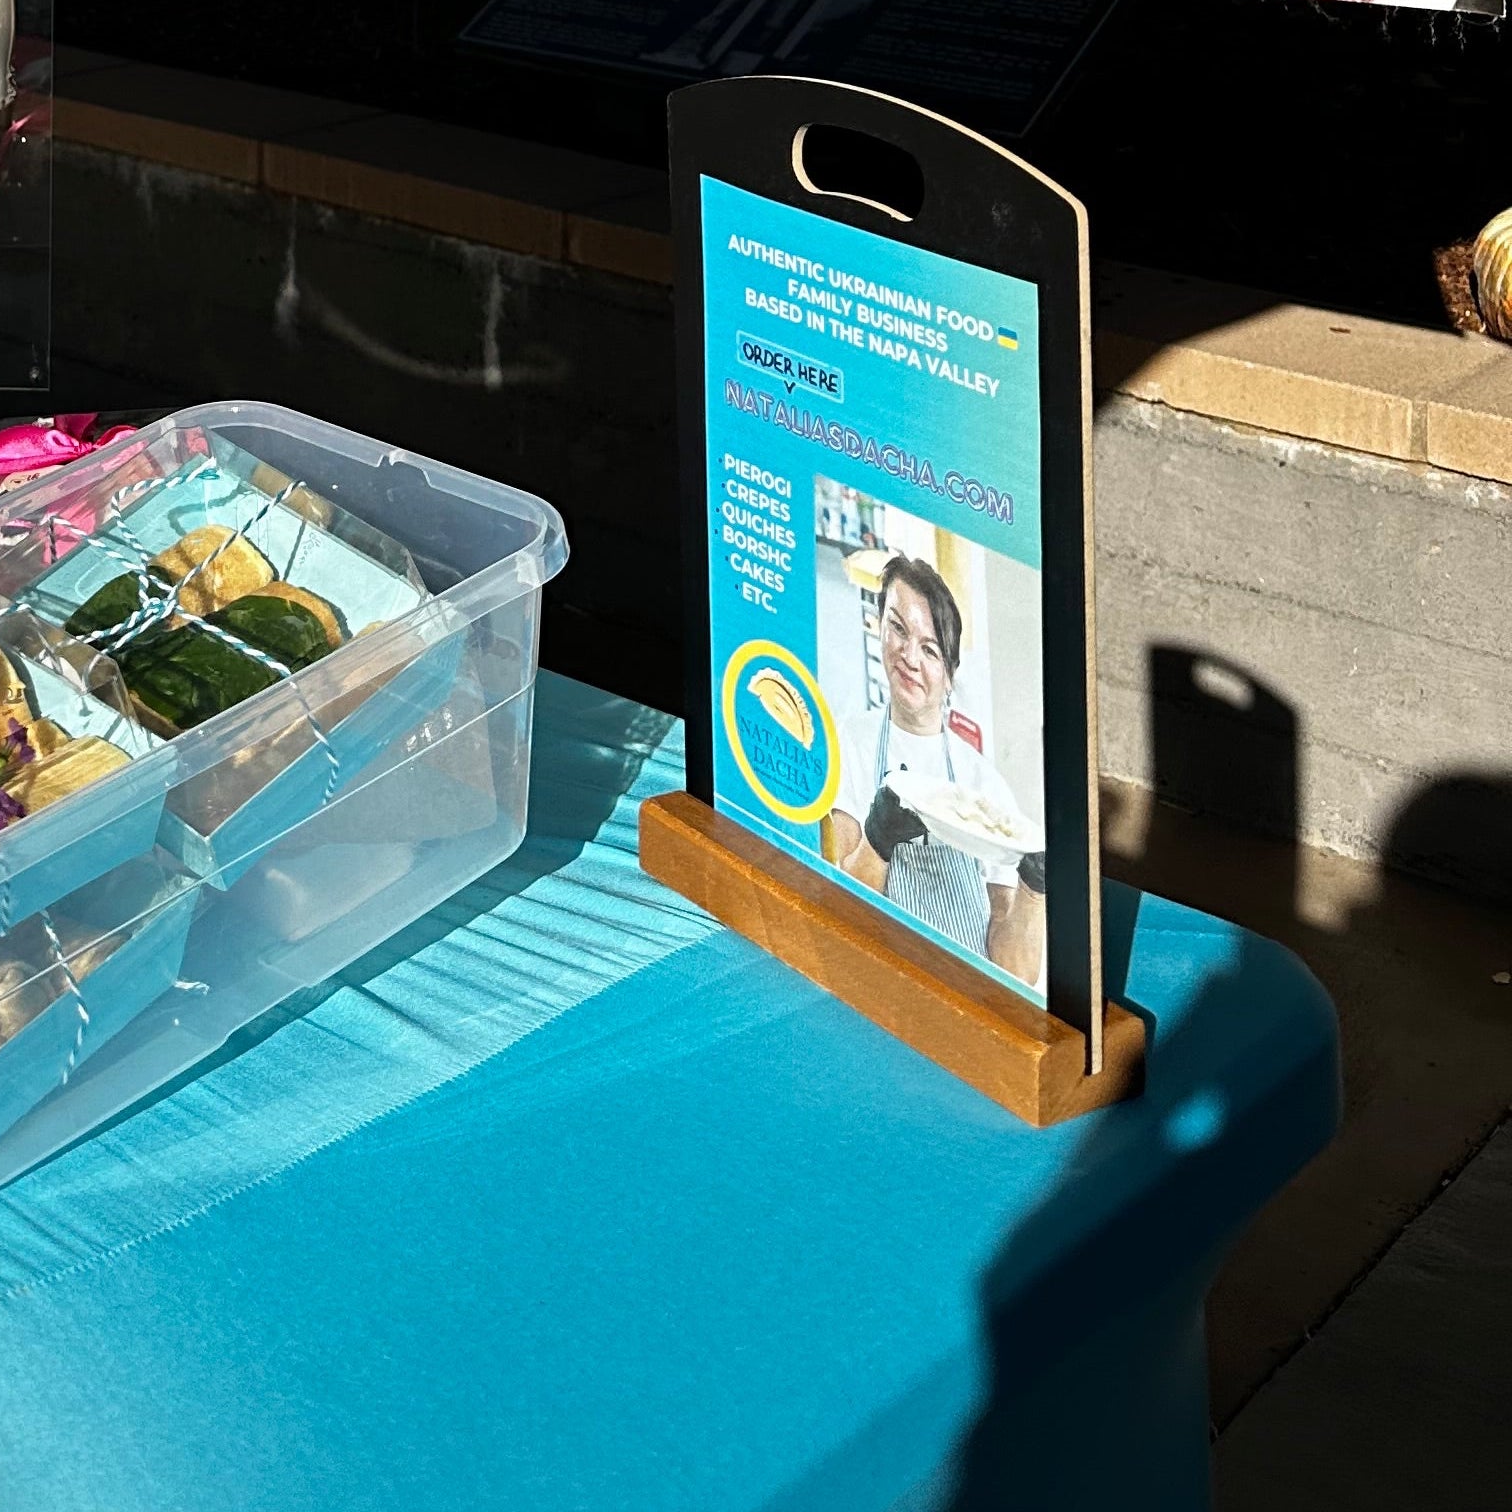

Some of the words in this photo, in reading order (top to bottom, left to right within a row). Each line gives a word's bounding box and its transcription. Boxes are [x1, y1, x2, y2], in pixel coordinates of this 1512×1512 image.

[728, 234, 824, 282] AUTHENTIC
[829, 267, 931, 320] UKRAINIAN
[936, 304, 994, 341] FOOD
[788, 279, 852, 318] FAMILY
[857, 303, 948, 352] BUSINESS
[745, 287, 803, 324] BASED
[807, 312, 825, 334] IN
[829, 317, 864, 347] THE
[869, 332, 922, 370] NAPA
[925, 354, 1000, 398] VALLEY
[743, 342, 795, 378] ORDER
[798, 363, 839, 393] HERE
[724, 378, 1014, 525] NATALIASDACHA.COM
[724, 453, 792, 498] PIEROGI
[726, 481, 791, 522] CREPES
[722, 502, 796, 549] QUICHES
[723, 528, 792, 572] BORSHC
[730, 555, 785, 593] CAKES
[742, 584, 778, 614] ETC.
[740, 716, 823, 776] NATALIA'S
[754, 745, 810, 792] DACHA
